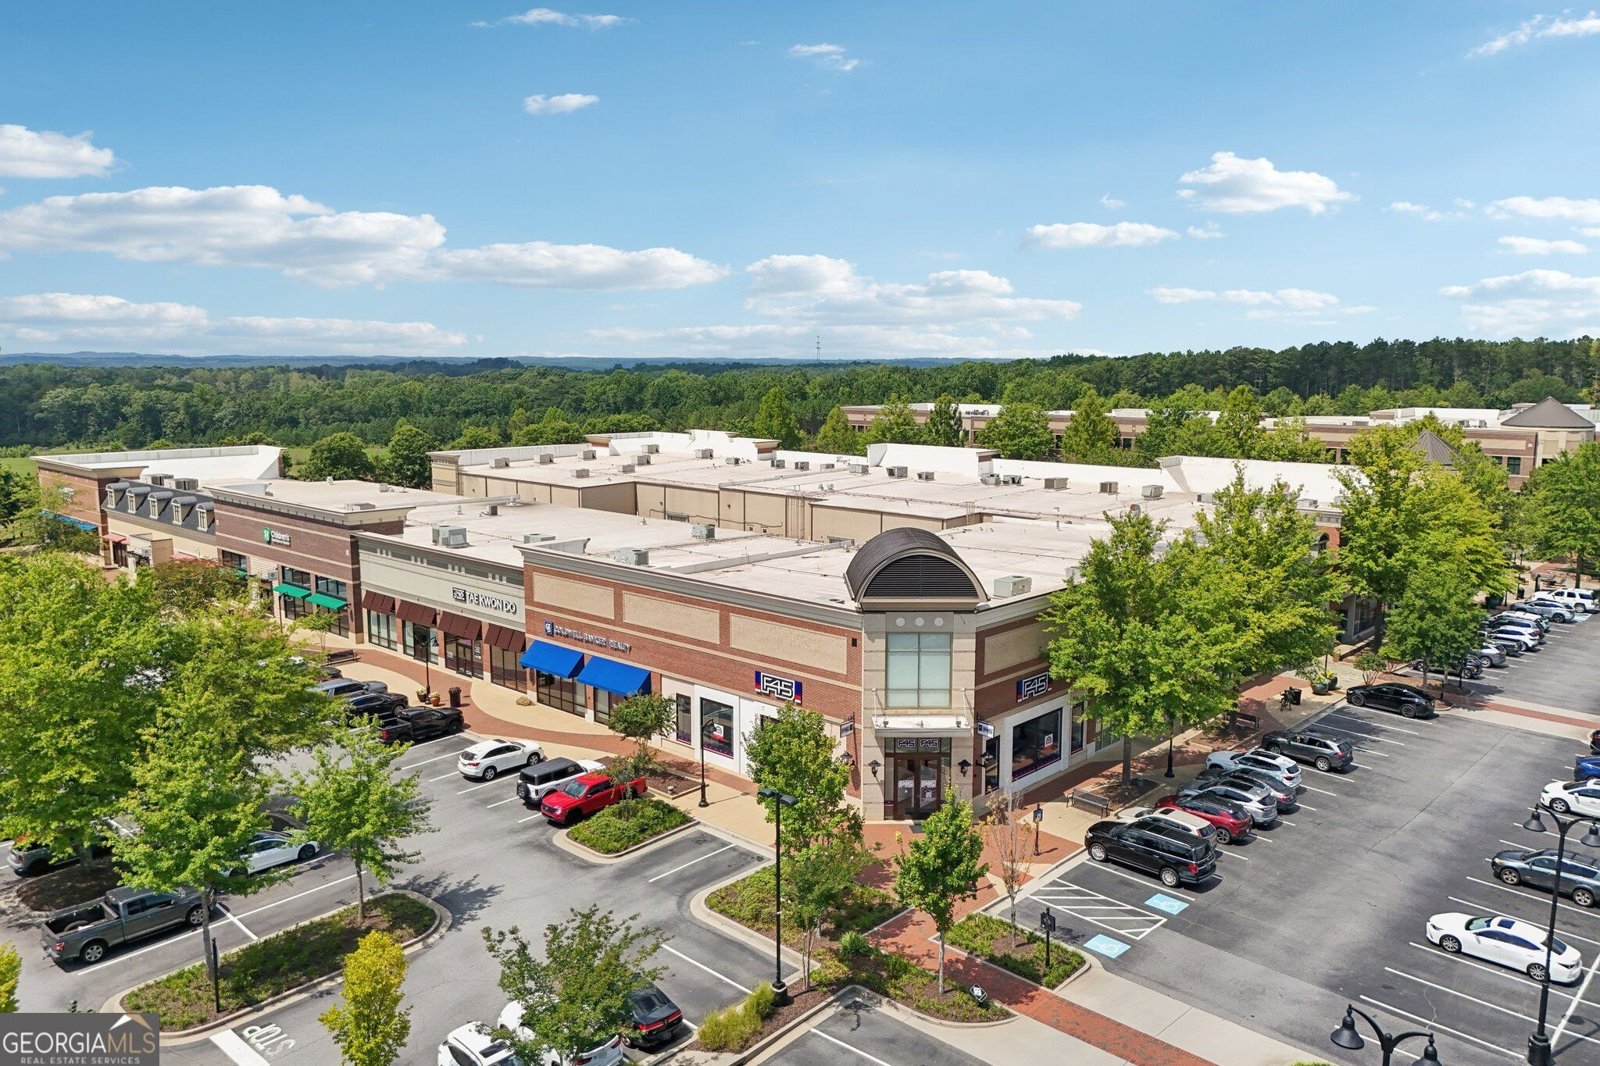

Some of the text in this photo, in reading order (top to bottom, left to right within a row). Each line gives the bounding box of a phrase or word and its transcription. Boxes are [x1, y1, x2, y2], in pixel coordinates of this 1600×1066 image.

[465, 591, 480, 605] TAE
[480, 594, 504, 611] KWON
[503, 600, 517, 614] DO
[761, 674, 794, 700] F45
[1022, 673, 1048, 700] F45
[898, 739, 916, 748] F45
[920, 739, 938, 748] F45
[242, 1023, 296, 1056] STOP
